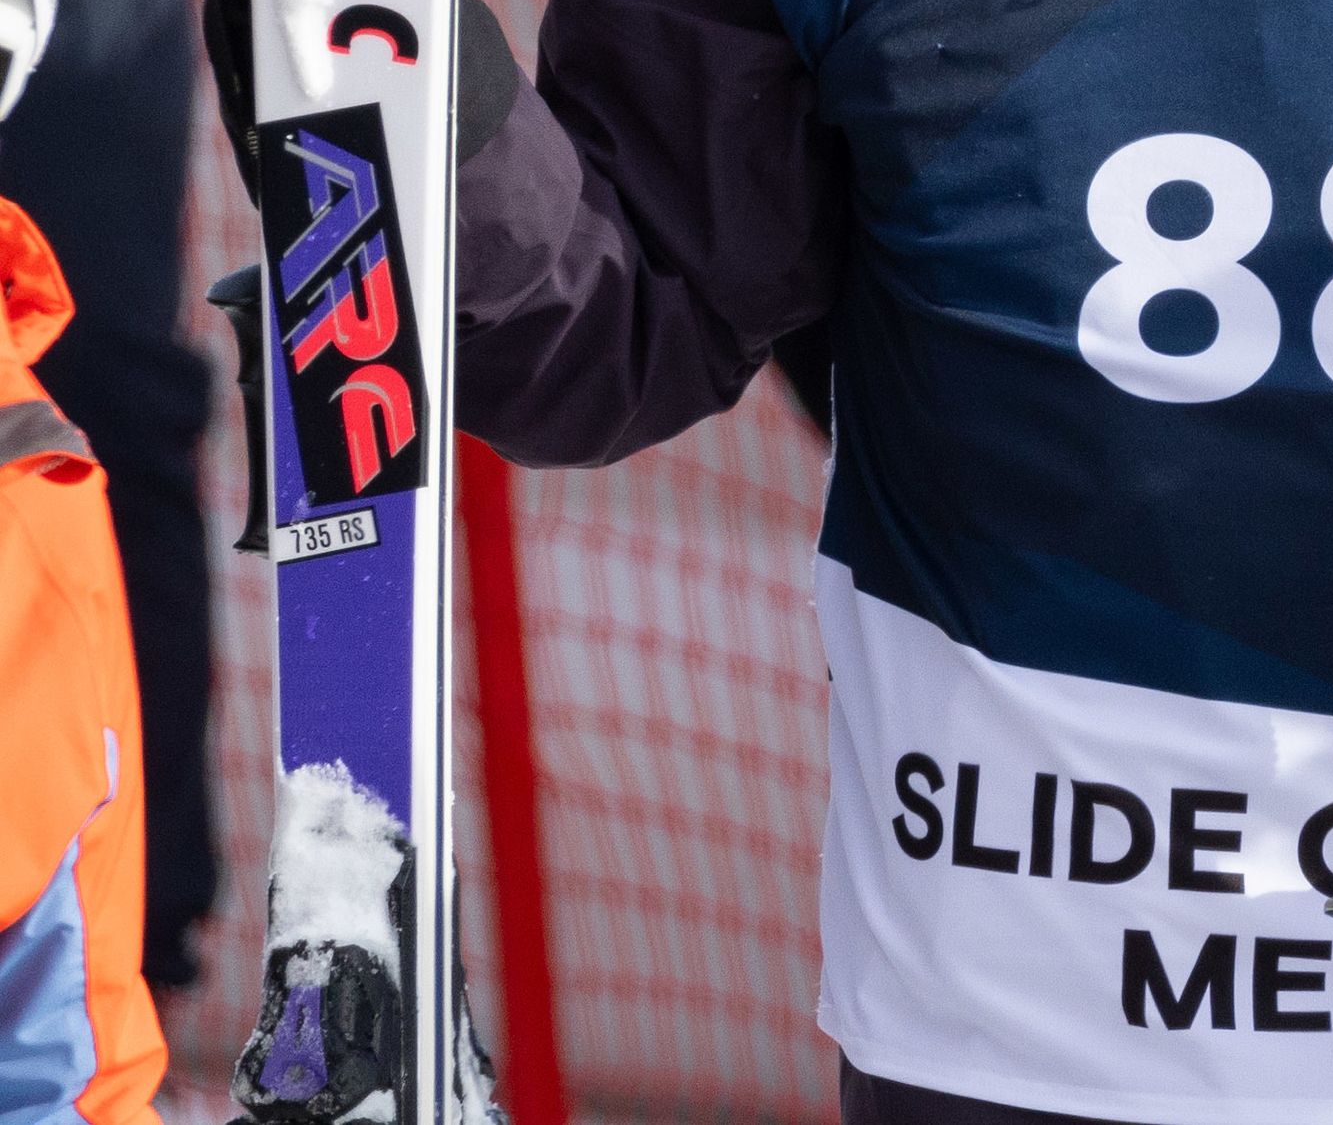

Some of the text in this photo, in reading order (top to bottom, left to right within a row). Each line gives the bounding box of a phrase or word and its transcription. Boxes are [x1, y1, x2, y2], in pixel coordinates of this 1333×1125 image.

[280, 129, 417, 495] ARC
[289, 515, 367, 555] 735 RS
[892, 751, 1248, 895] SLIDE
